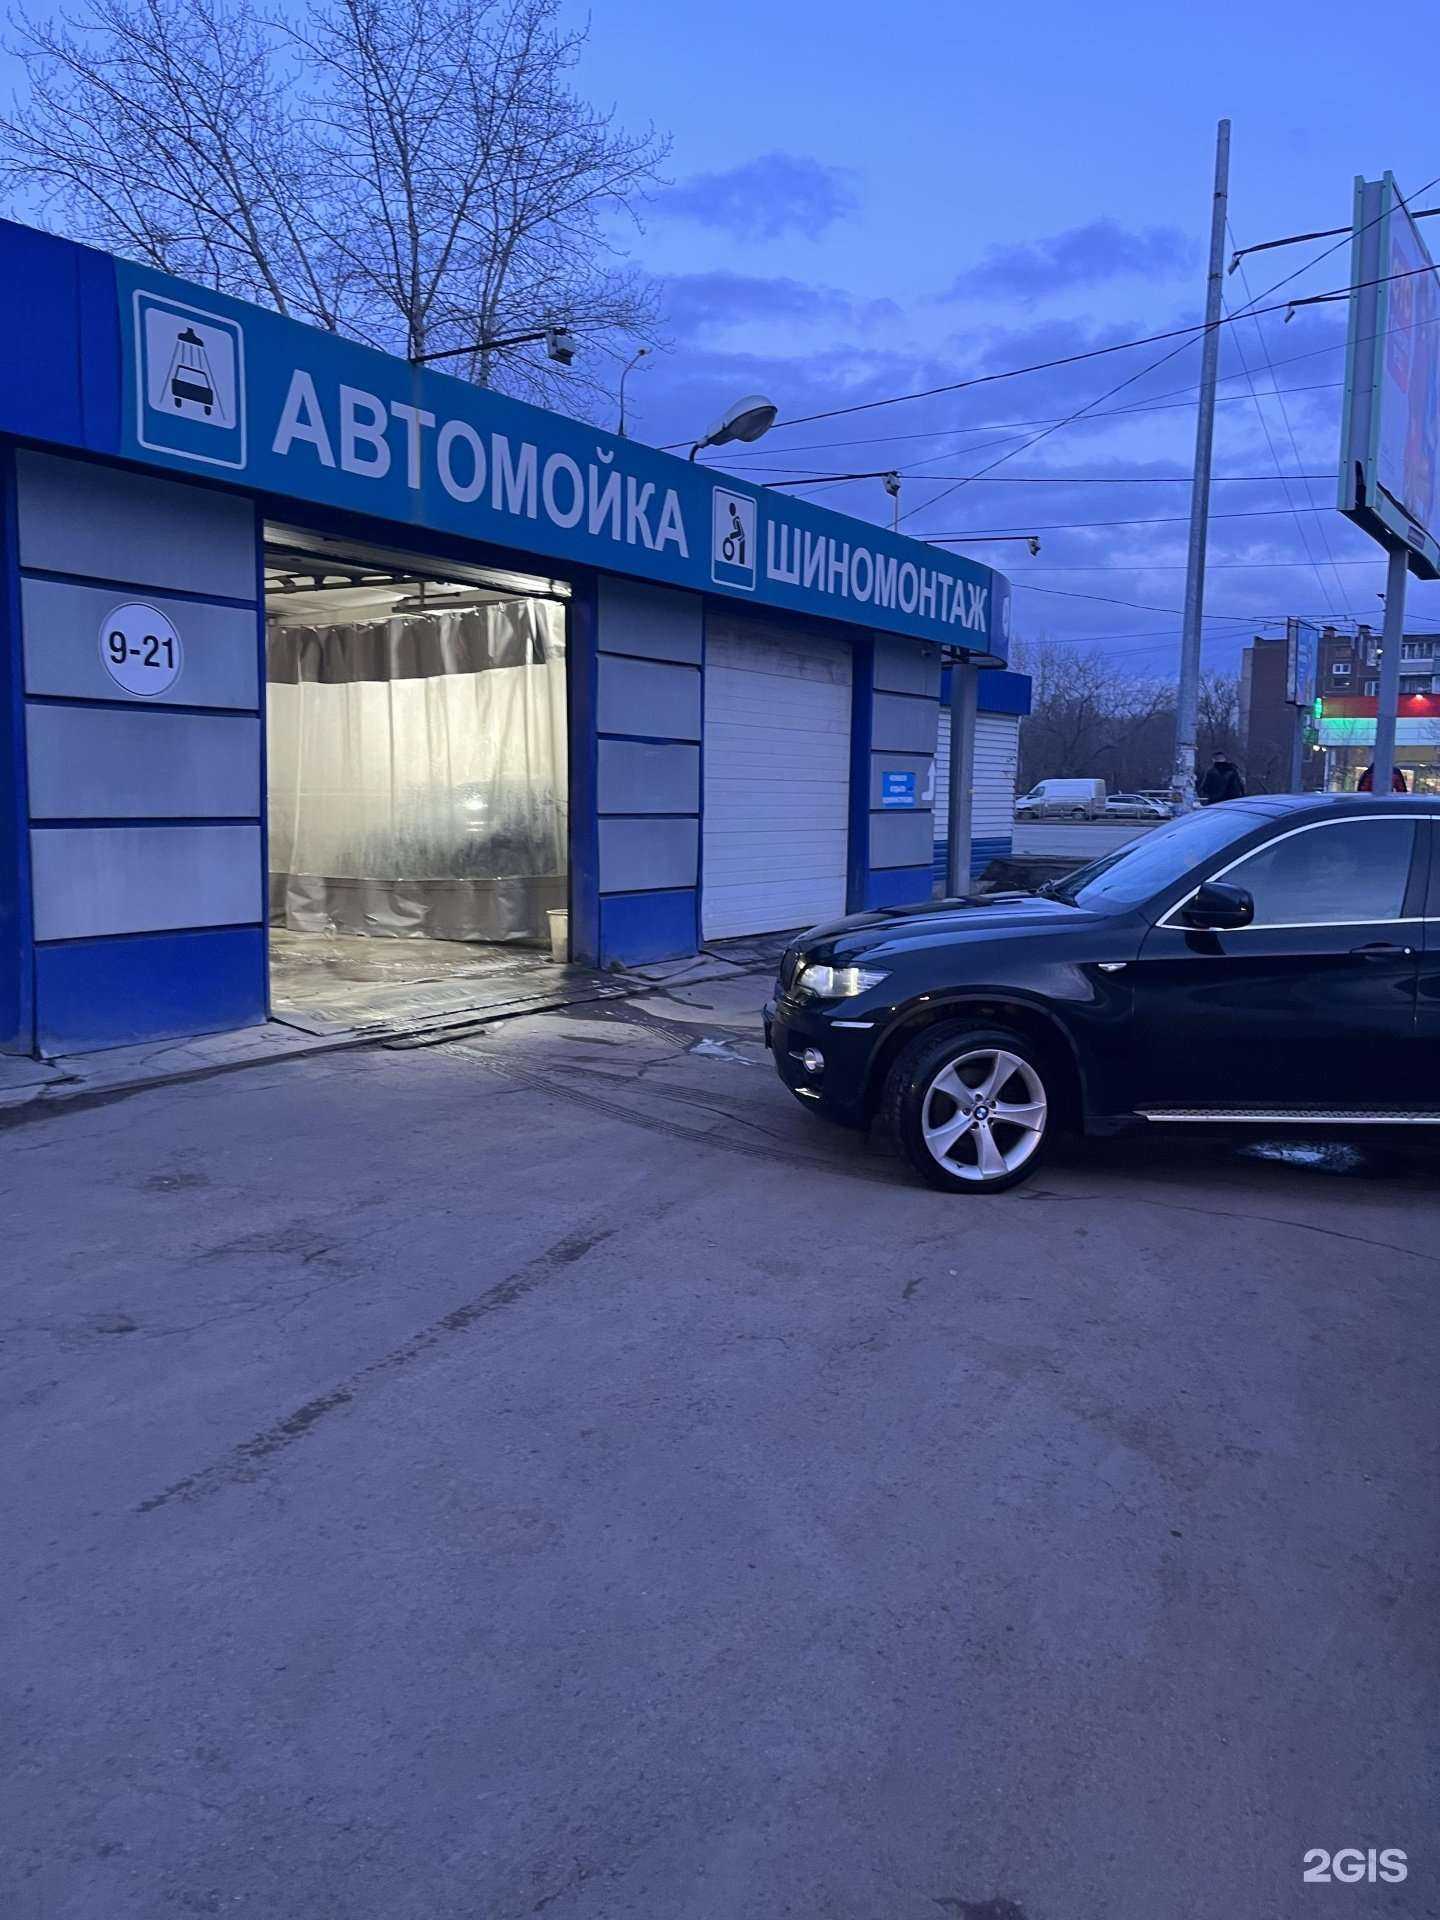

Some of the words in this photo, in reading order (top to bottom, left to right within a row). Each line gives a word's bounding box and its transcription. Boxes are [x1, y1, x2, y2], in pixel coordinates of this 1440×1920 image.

[272, 368, 690, 559] АВТОМОЙКА
[766, 519, 988, 633] ШИНОМОНТАЖ
[109, 630, 174, 669] 9-21
